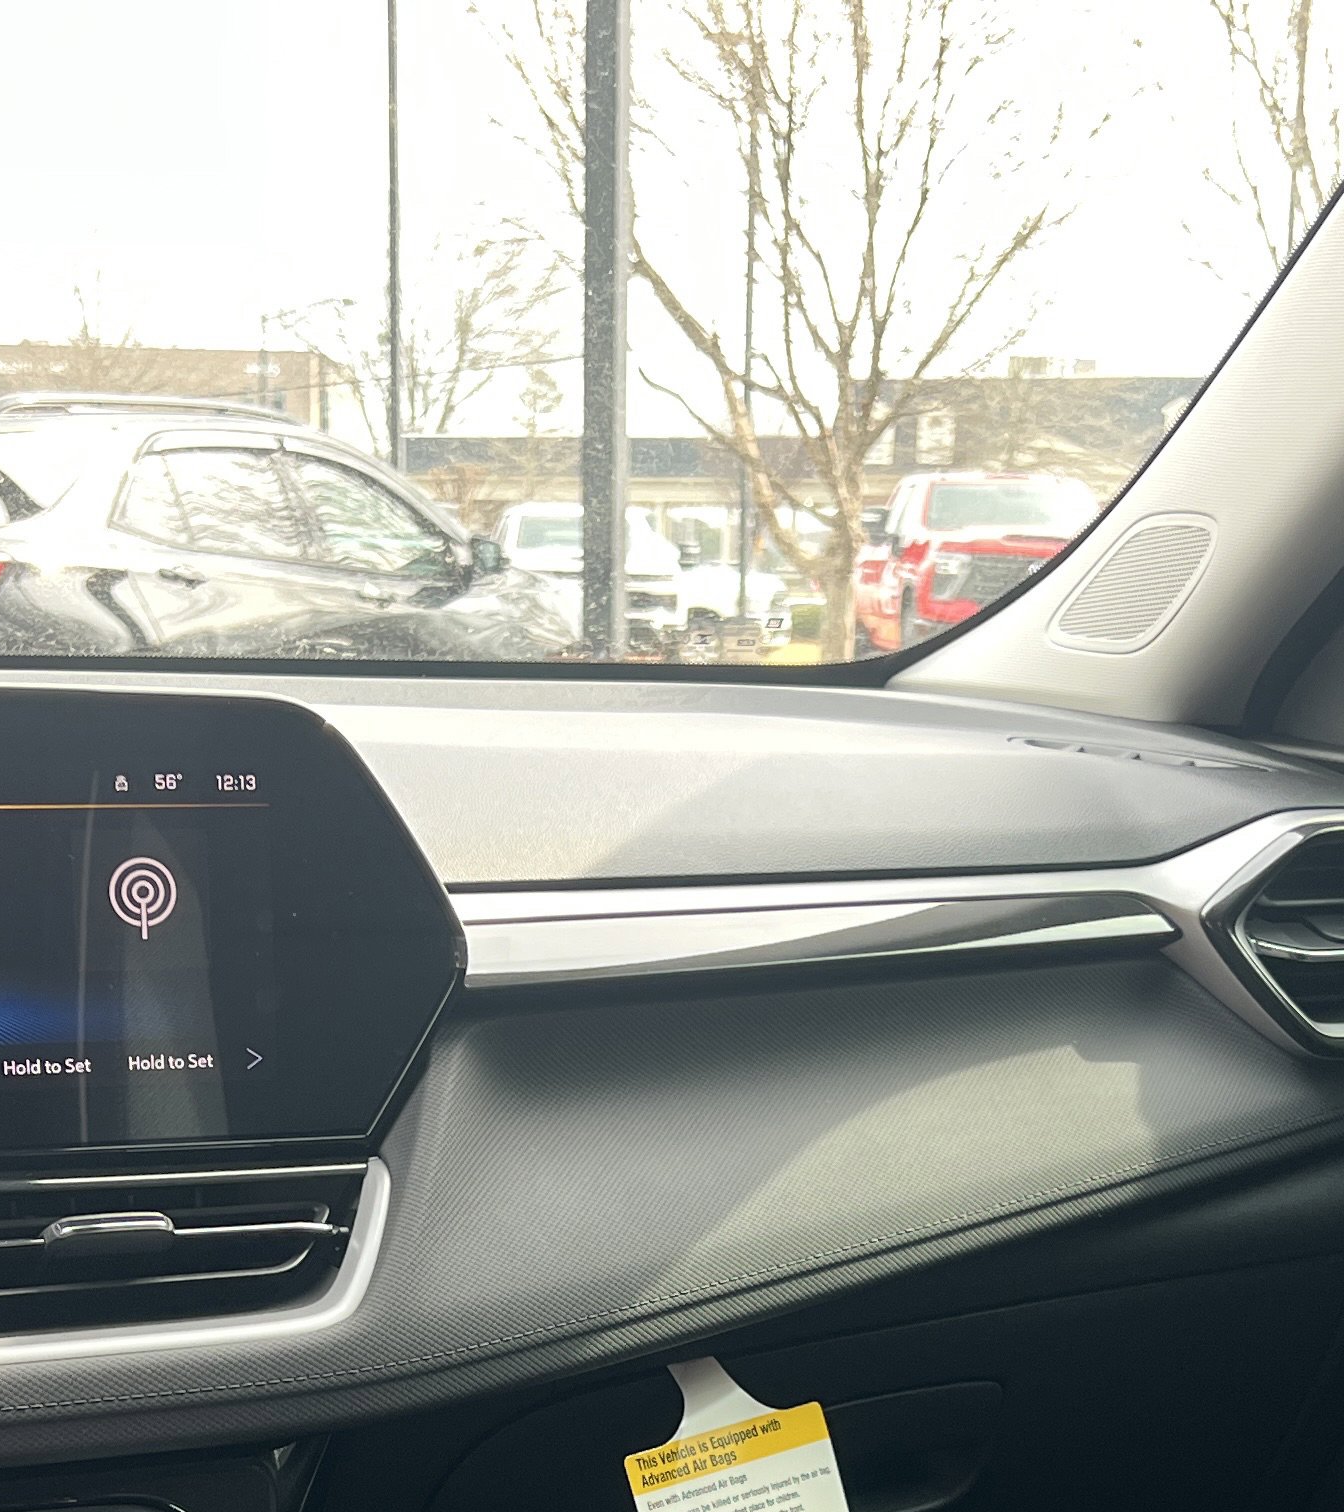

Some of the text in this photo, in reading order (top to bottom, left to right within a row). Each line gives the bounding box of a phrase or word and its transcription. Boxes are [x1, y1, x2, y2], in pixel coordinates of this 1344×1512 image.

[154, 772, 183, 790] 56°
[216, 774, 257, 791] 12:13
[3, 1057, 92, 1076] Hold to Set
[128, 1053, 214, 1071] Hold to Set
[636, 1418, 781, 1471] This Vehicle is Equipped with
[642, 1450, 737, 1487] Advanced Air Bags
